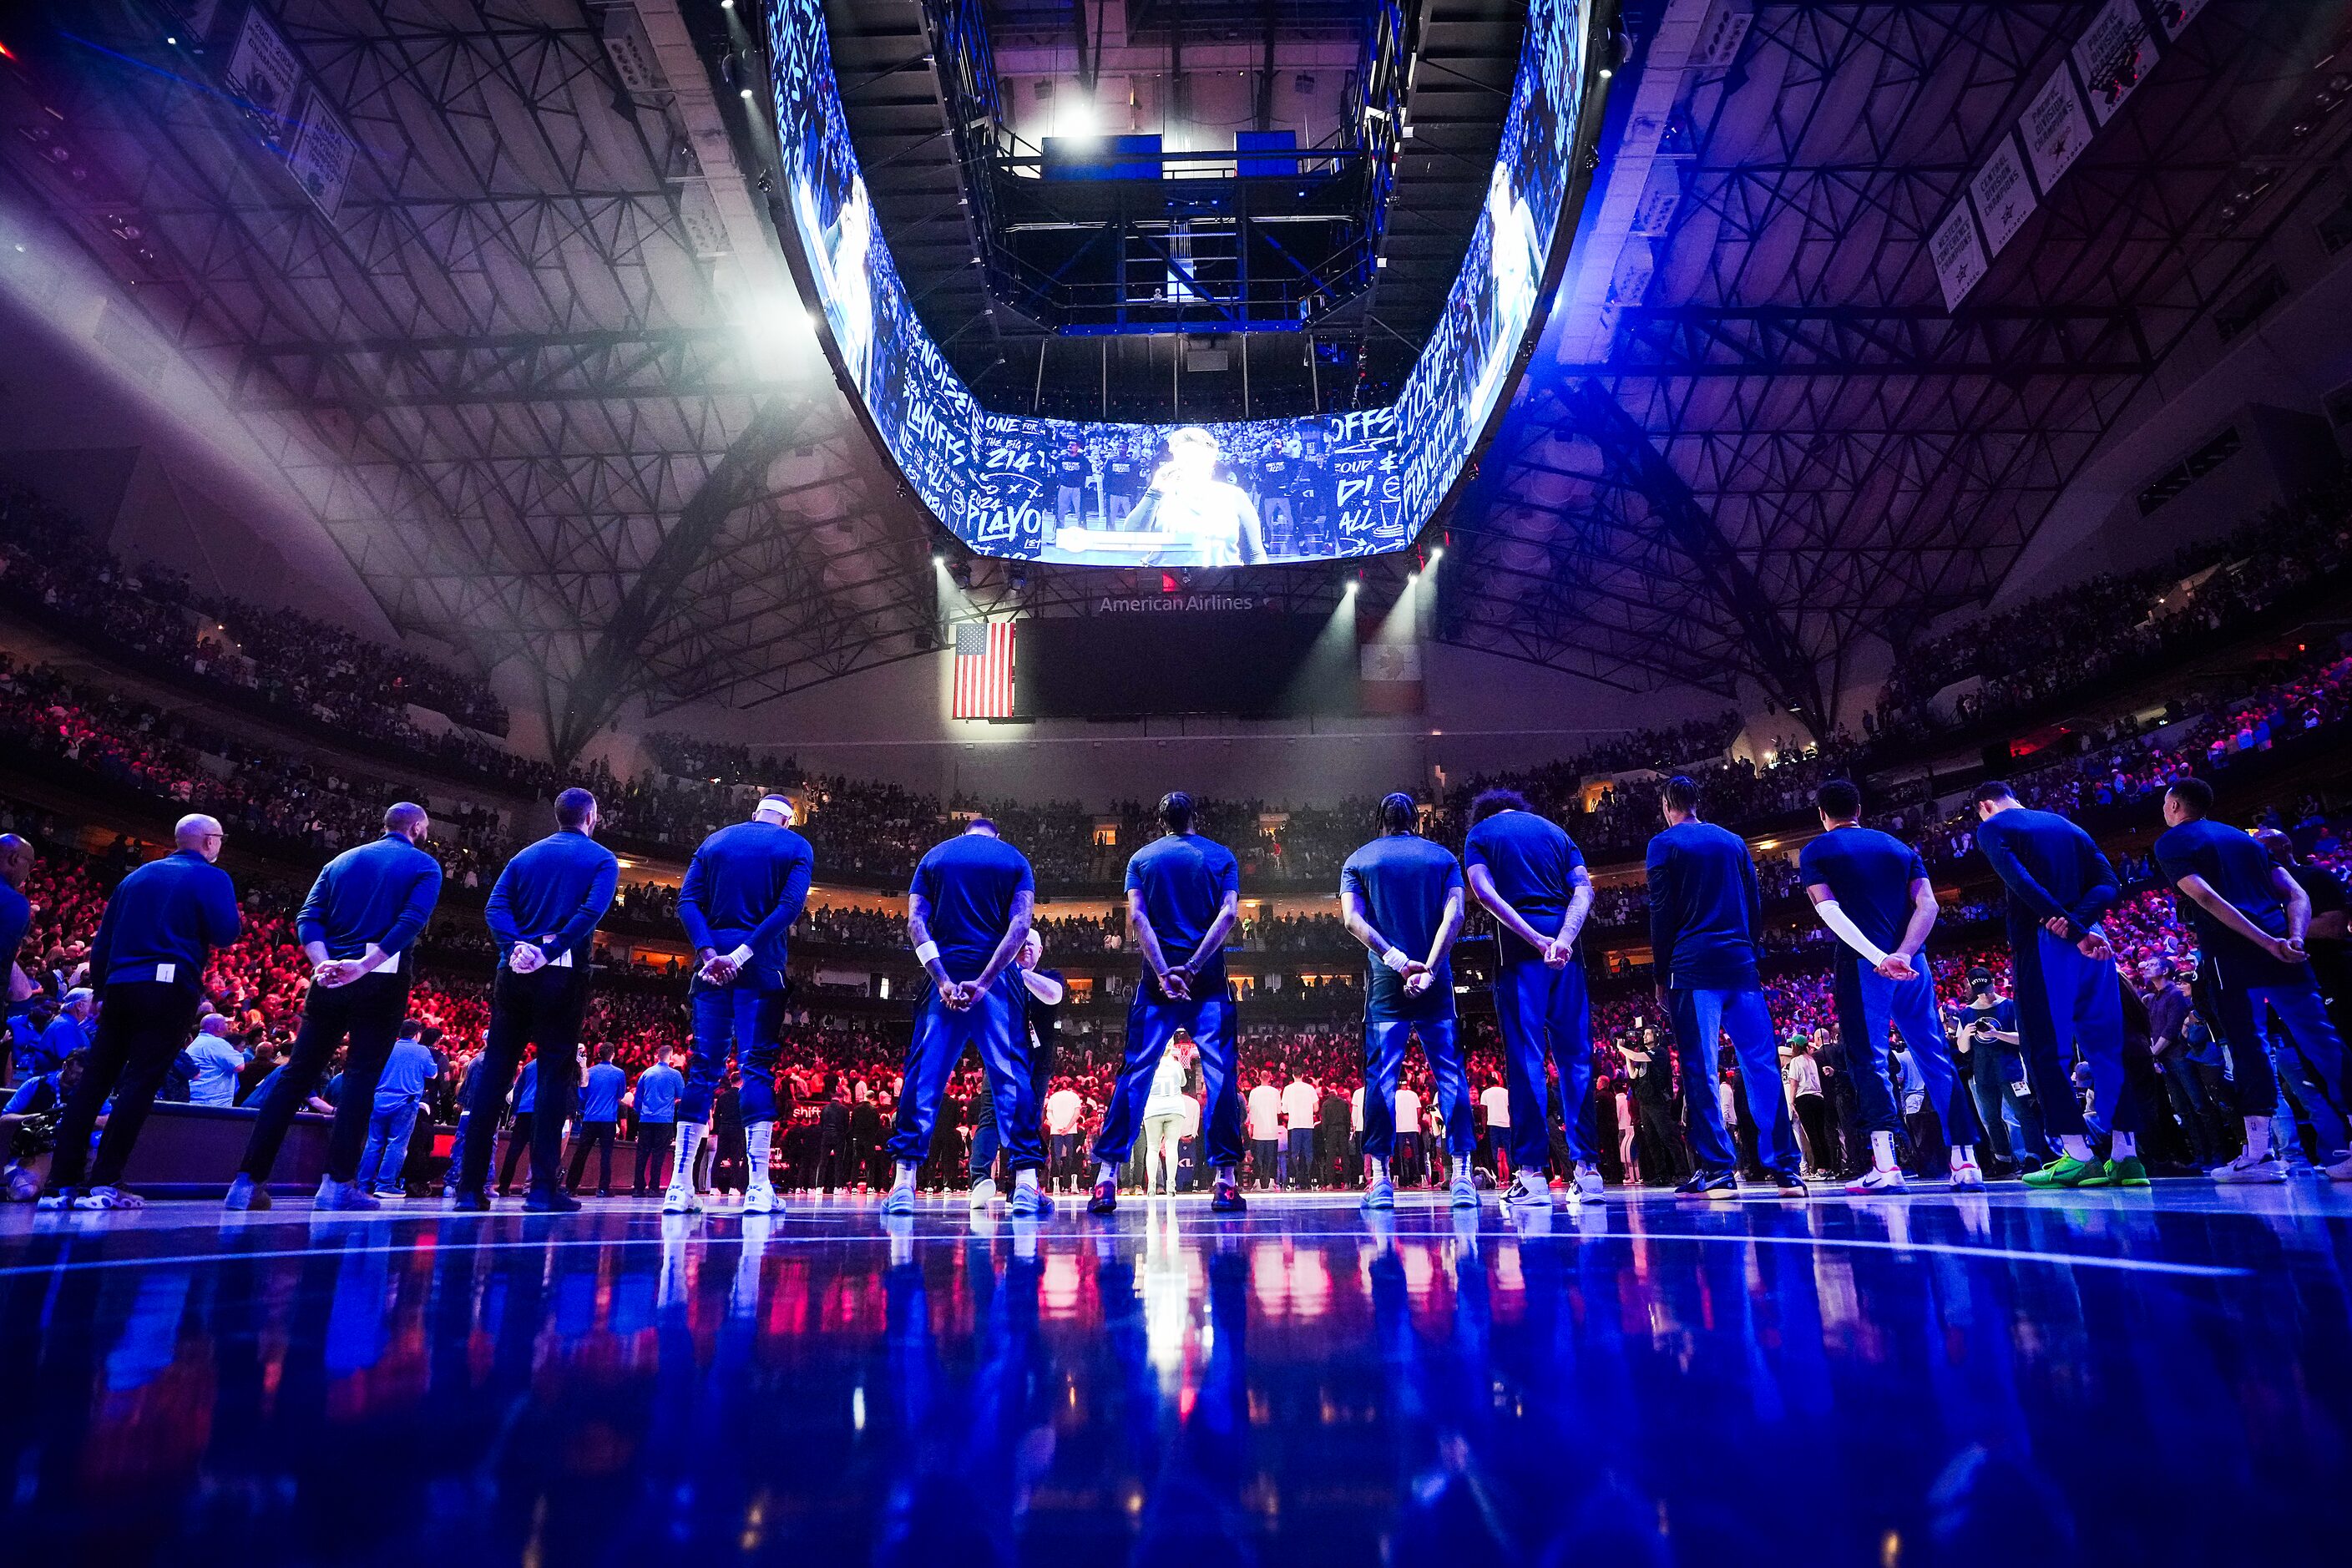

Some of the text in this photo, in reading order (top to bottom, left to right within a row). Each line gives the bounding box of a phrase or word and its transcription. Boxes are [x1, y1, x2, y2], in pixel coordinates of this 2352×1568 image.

[248, 37, 291, 94] CHAMPIONS
[321, 114, 341, 149] NBA
[2034, 99, 2074, 153] CHAMPIONS
[2035, 94, 2064, 136] DIVISION
[1980, 154, 2008, 191] CENTRAL
[1985, 163, 2011, 201] DIVISION
[1984, 169, 2020, 217] CHAMPIONS
[1936, 218, 1970, 266] CONFERENCE
[1938, 214, 1963, 250] WESTERN
[1941, 231, 1972, 276] CHAMPIONS
[985, 416, 1038, 432] ONE FOR
[985, 437, 1002, 447] THE
[924, 459, 945, 493] ALL
[985, 447, 1035, 473] 214
[1403, 405, 1455, 521] PLAYOFFS
[1439, 453, 1463, 503] 1980
[920, 486, 946, 523] 1980
[969, 489, 1003, 511] 2024
[1338, 508, 1377, 536] ALL
[1099, 594, 1252, 612] American Airlines
